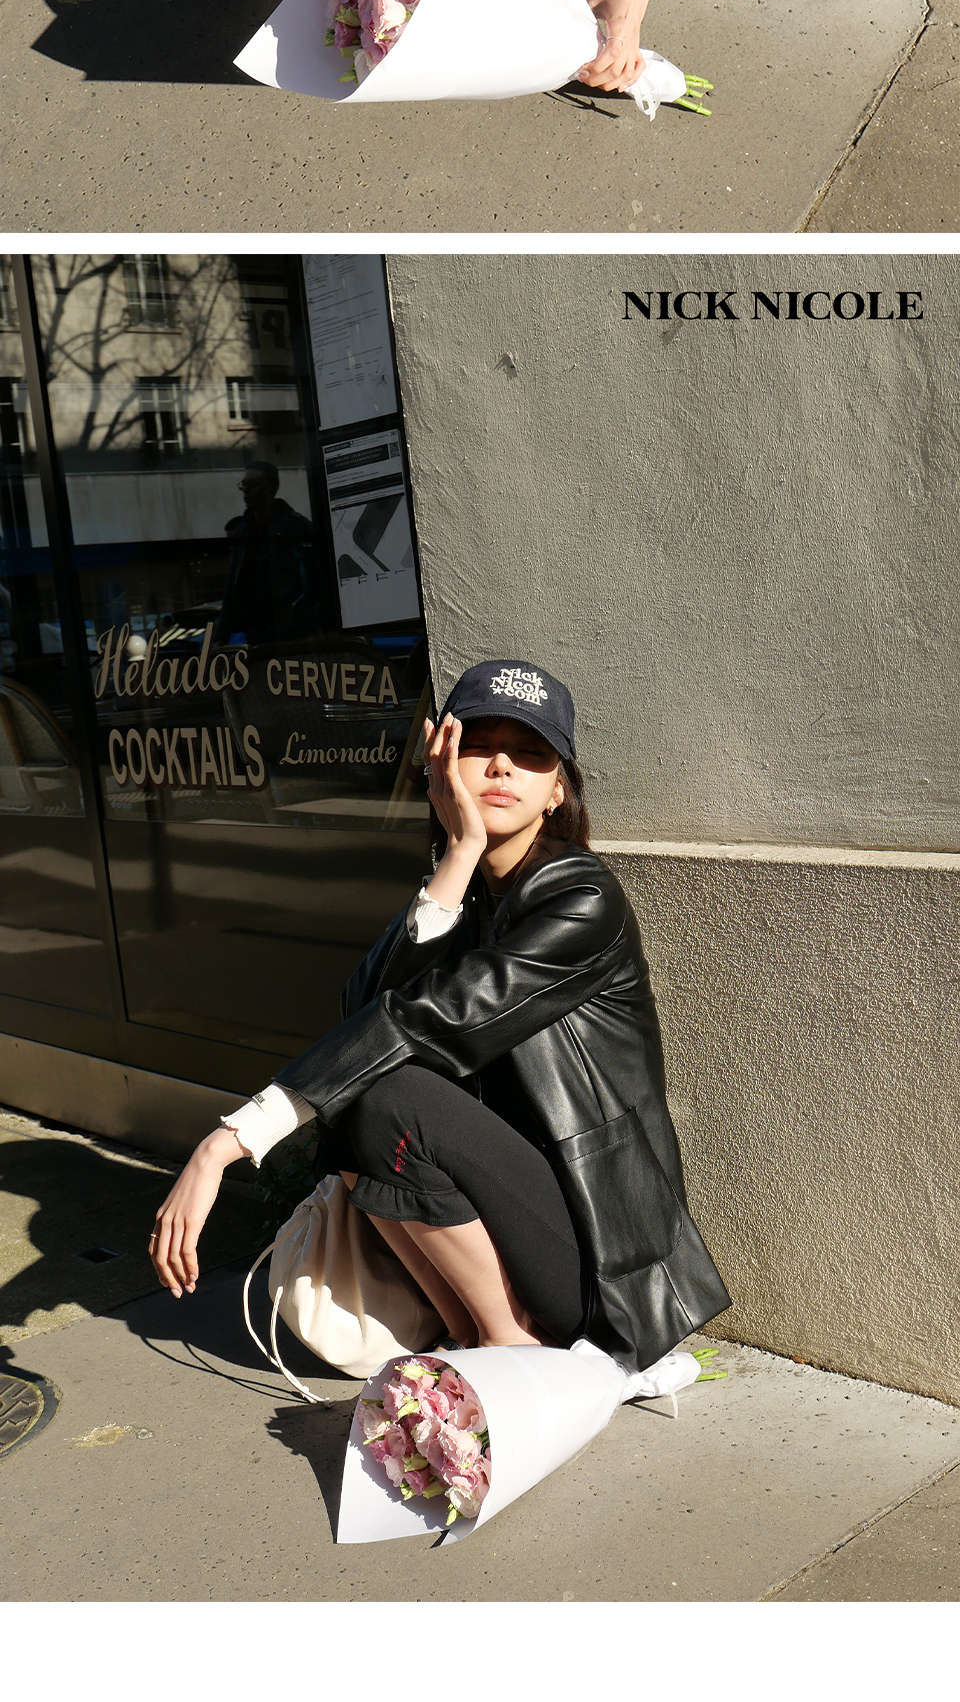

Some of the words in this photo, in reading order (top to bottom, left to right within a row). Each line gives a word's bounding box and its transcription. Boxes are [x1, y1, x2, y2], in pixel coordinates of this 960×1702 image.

[95, 621, 250, 699] Helados
[500, 667, 544, 687] Nick
[266, 658, 399, 706] CERVEZA
[489, 676, 549, 700] Nicole
[108, 724, 266, 788] COCKTAILS
[279, 729, 398, 766] Limonade
